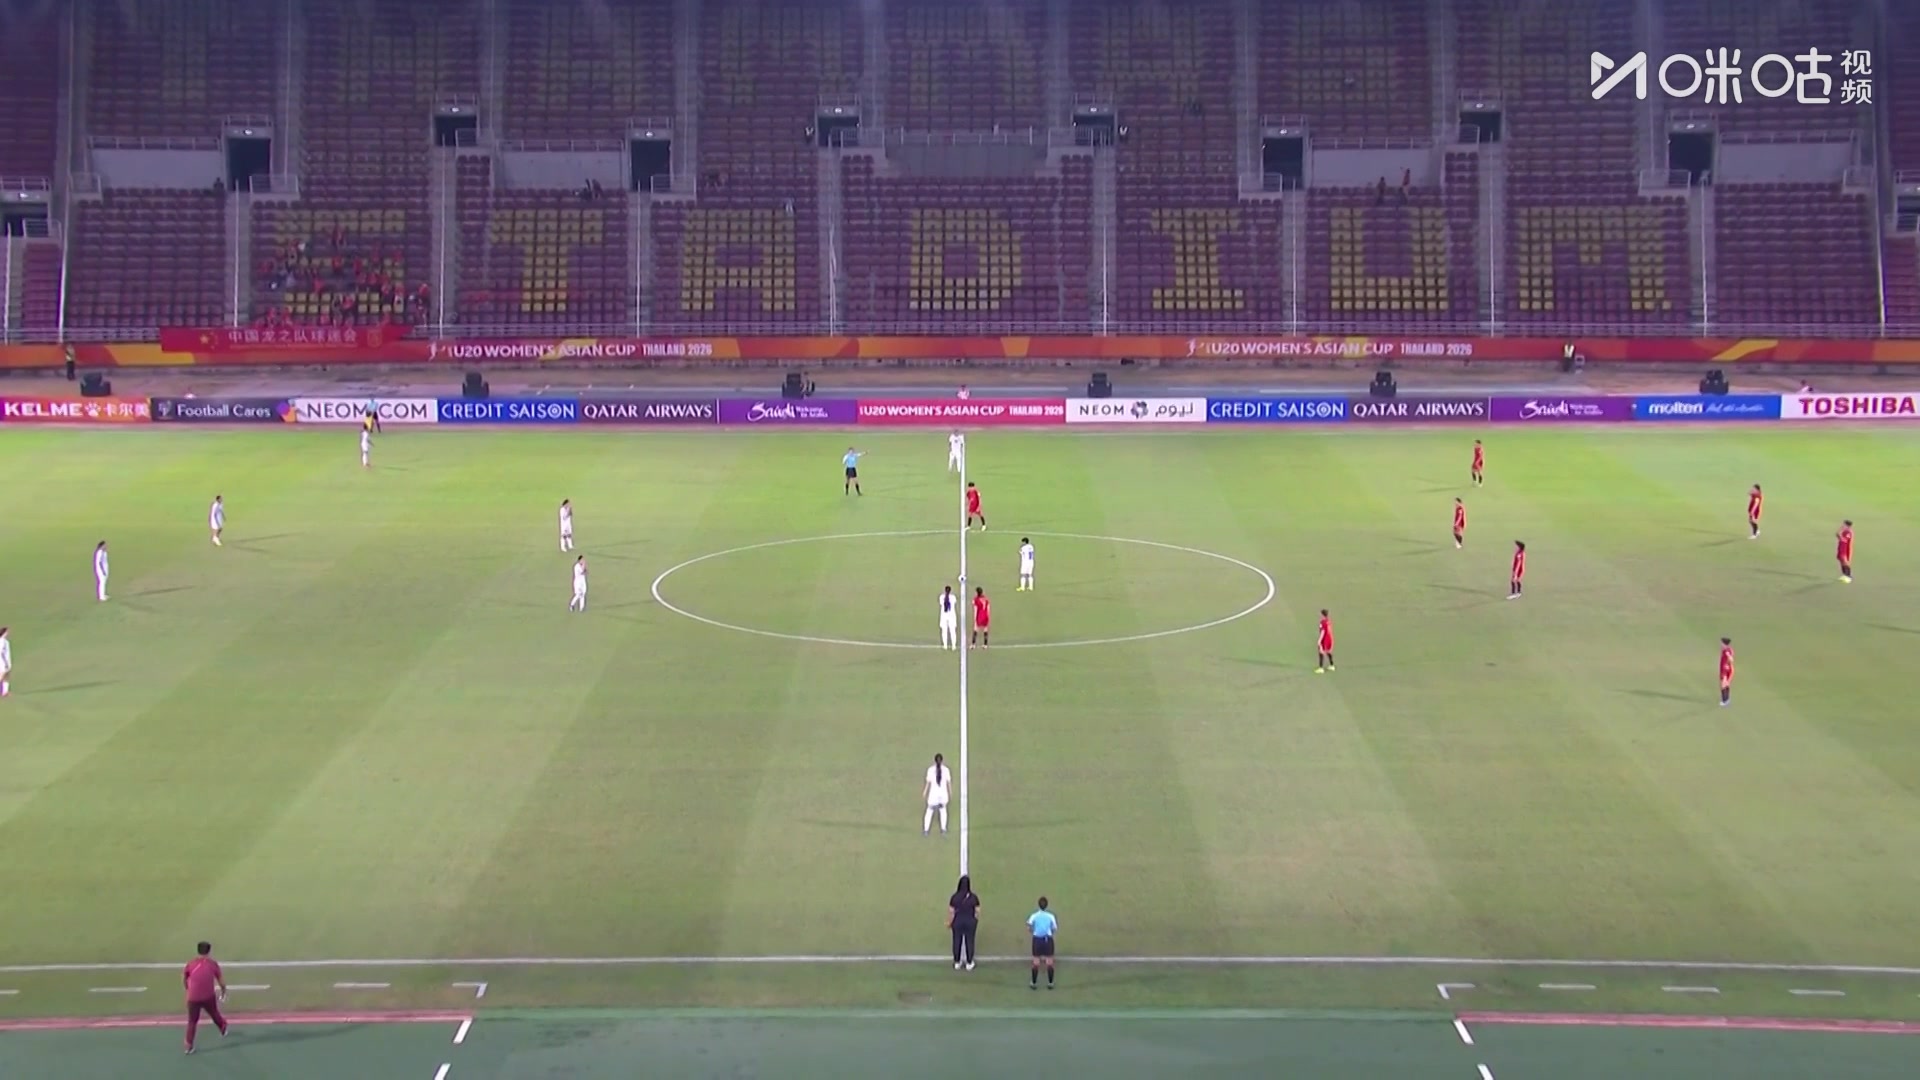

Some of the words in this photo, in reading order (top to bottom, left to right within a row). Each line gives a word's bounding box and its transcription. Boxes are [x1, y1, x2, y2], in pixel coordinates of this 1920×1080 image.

[483, 345, 554, 358] WOMEN'S
[559, 344, 603, 357] ASIAN
[605, 344, 636, 356] CUP
[642, 343, 685, 356] THAILAND
[687, 343, 712, 356] 2026
[1241, 342, 1313, 355] WOMEN'S
[1314, 342, 1360, 355] ASIAN
[1362, 343, 1394, 355] CUP
[1401, 343, 1444, 355] THAILAND
[1446, 343, 1473, 356] 2026
[4, 402, 83, 417] KELME
[104, 402, 149, 417] 卡尔美
[177, 404, 229, 416] Football
[232, 403, 271, 418] Cares
[441, 403, 503, 419] CREDIT
[508, 403, 575, 419] SAISON
[584, 403, 638, 419] QATAR
[644, 403, 713, 418] AIRWAYS
[887, 405, 942, 416] WOMEN'S
[943, 405, 979, 416] ASIAN
[980, 405, 1004, 416] CUP
[1009, 405, 1042, 416] THAILAND
[1080, 404, 1124, 416] NEOM
[1210, 401, 1272, 418] CREDIT
[1277, 401, 1344, 418] SAISON
[1353, 402, 1408, 417] QATAR
[1415, 401, 1484, 417] AIRWAYS
[1649, 401, 1703, 415] molten
[1799, 397, 1915, 414] TOSHIBA
